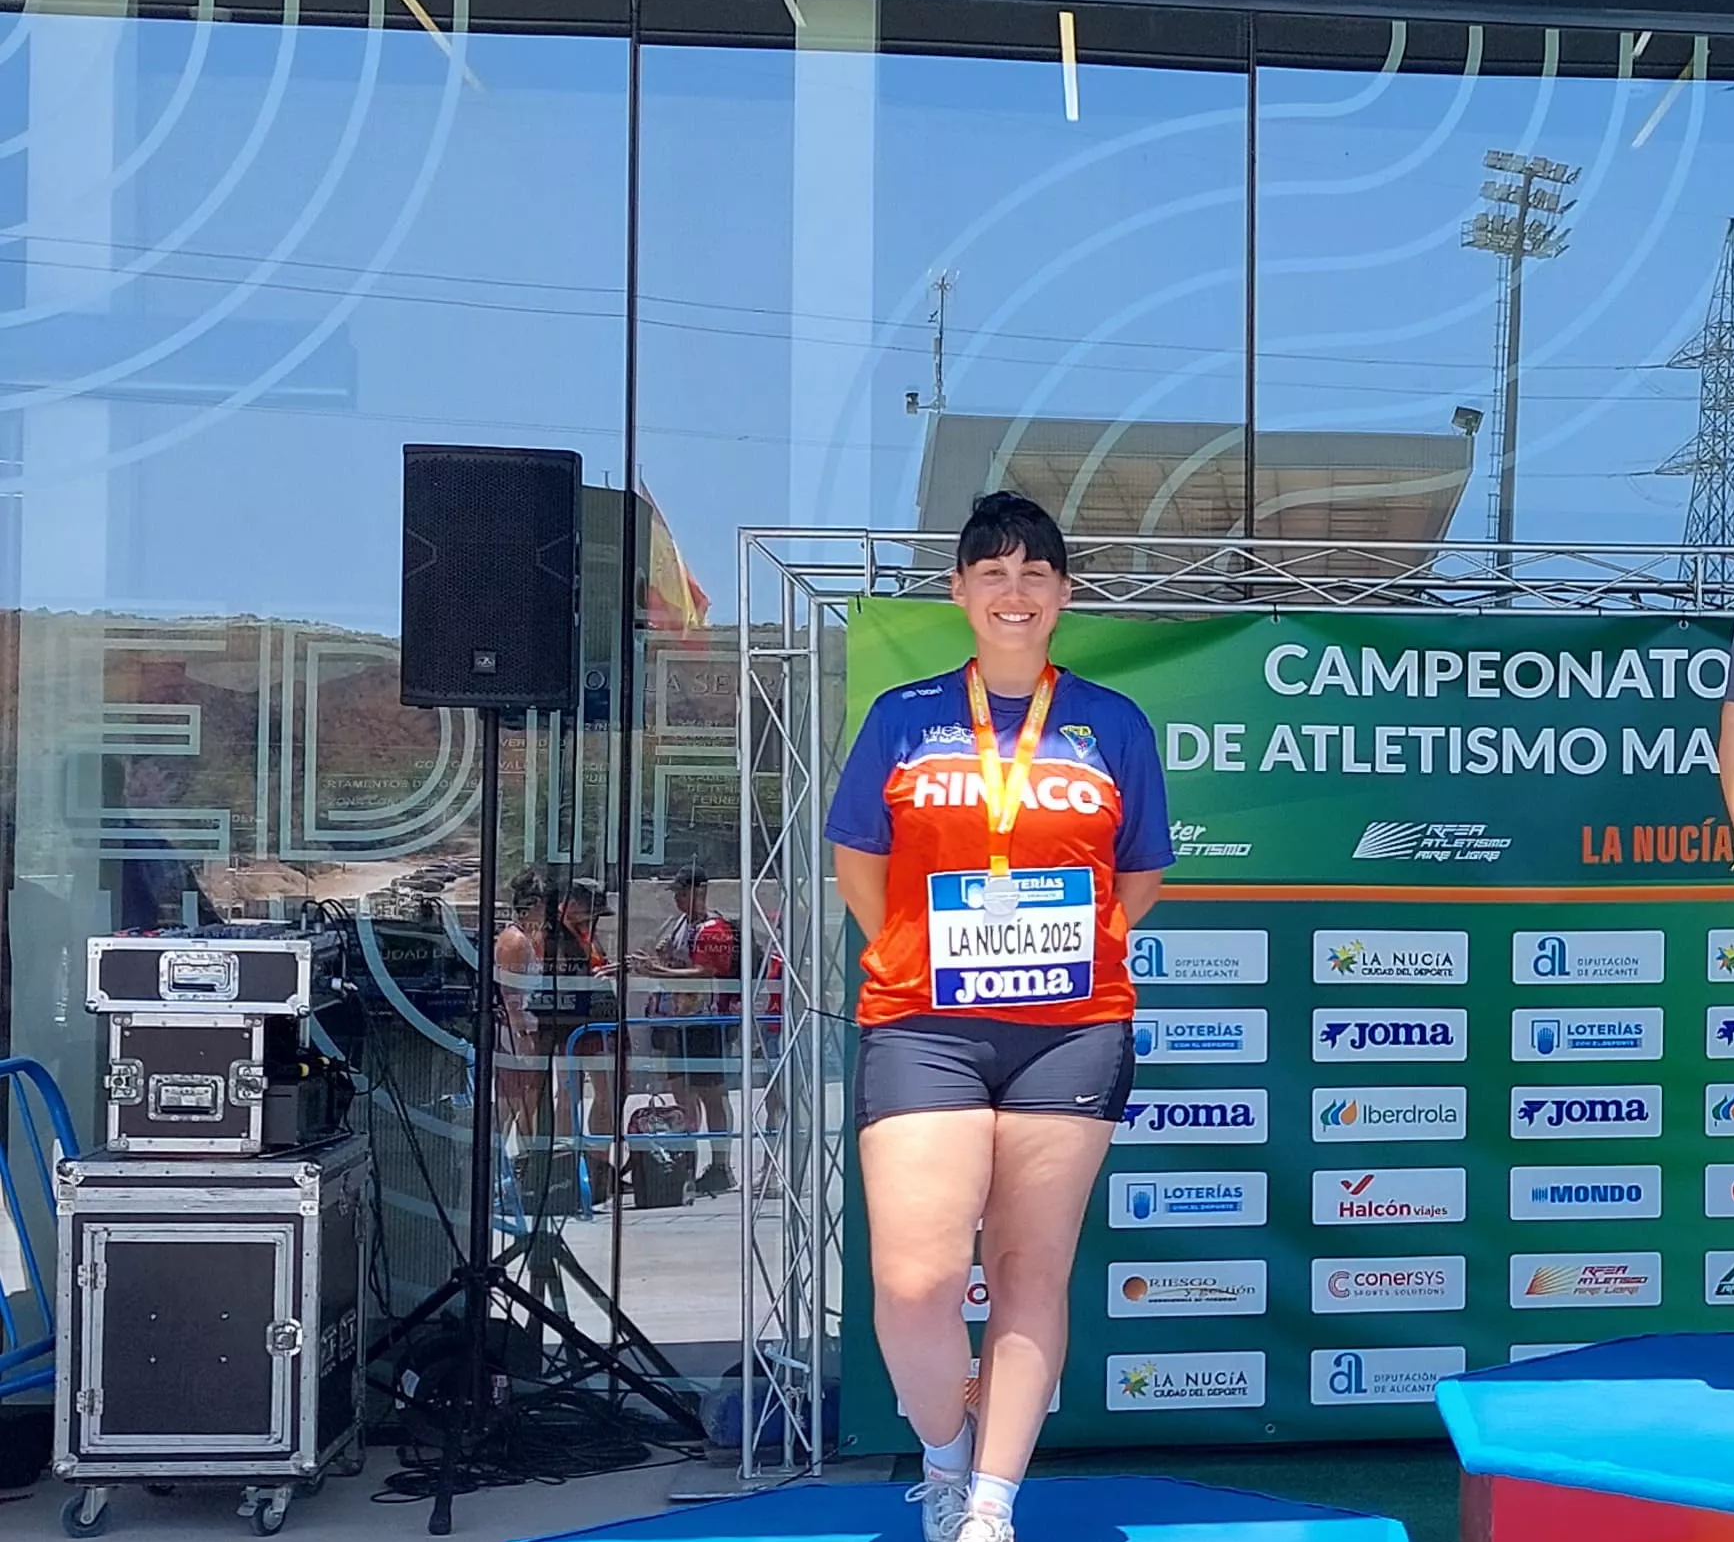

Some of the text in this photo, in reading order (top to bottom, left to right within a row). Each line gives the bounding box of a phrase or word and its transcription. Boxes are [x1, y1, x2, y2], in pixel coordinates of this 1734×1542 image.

[1264, 644, 1730, 700] CAMPEONATO
[1166, 723, 1245, 772] DE
[1259, 725, 1608, 775] ATLETISMO
[1420, 838, 1512, 848] ATLETISMO
[1583, 818, 1732, 864] LA NUCÍA
[948, 917, 1082, 956] LA NUCÍA 2025
[1362, 953, 1381, 966] LA
[1165, 1022, 1243, 1036] LOTERÍAS
[1567, 1021, 1643, 1036] LOTERÍAS
[1362, 1104, 1457, 1124] Iberdrola
[1164, 1184, 1243, 1199] LOTERÍAS
[1550, 1184, 1642, 1204] MONDO
[1340, 1200, 1448, 1217] Halcón viajes
[1154, 1373, 1174, 1388] LA
[1154, 1388, 1186, 1398] CIUDAD
[1207, 1386, 1248, 1397] DEPORTE
